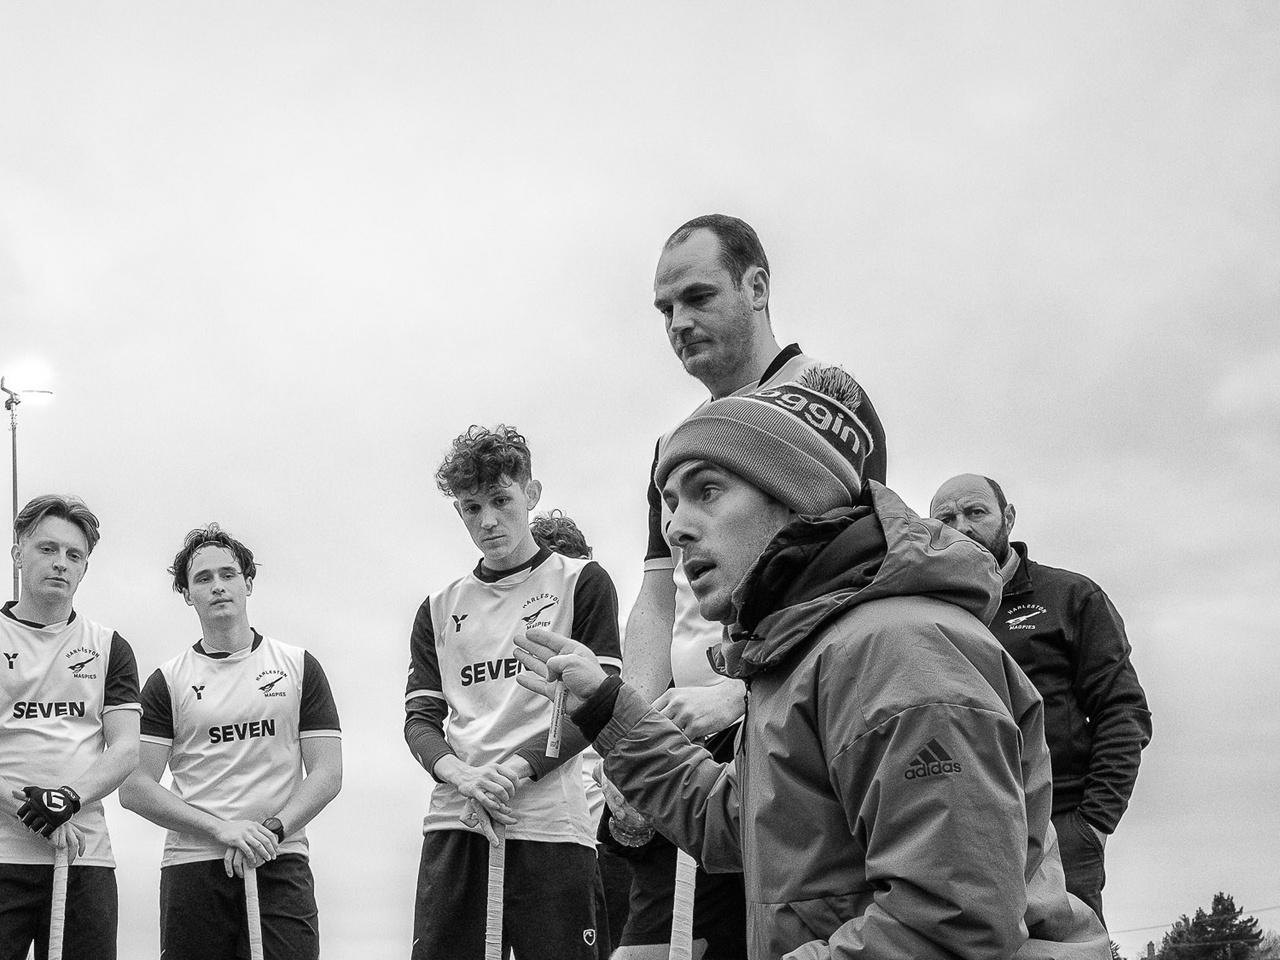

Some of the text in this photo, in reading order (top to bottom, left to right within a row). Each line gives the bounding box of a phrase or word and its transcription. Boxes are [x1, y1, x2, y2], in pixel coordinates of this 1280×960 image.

[755, 390, 860, 454] oggin
[65, 646, 101, 659] HARLESTON
[255, 669, 288, 682] HARLESTON
[12, 701, 86, 720] SEVEN
[208, 718, 276, 744] SEVEN
[904, 762, 962, 780] adidas
